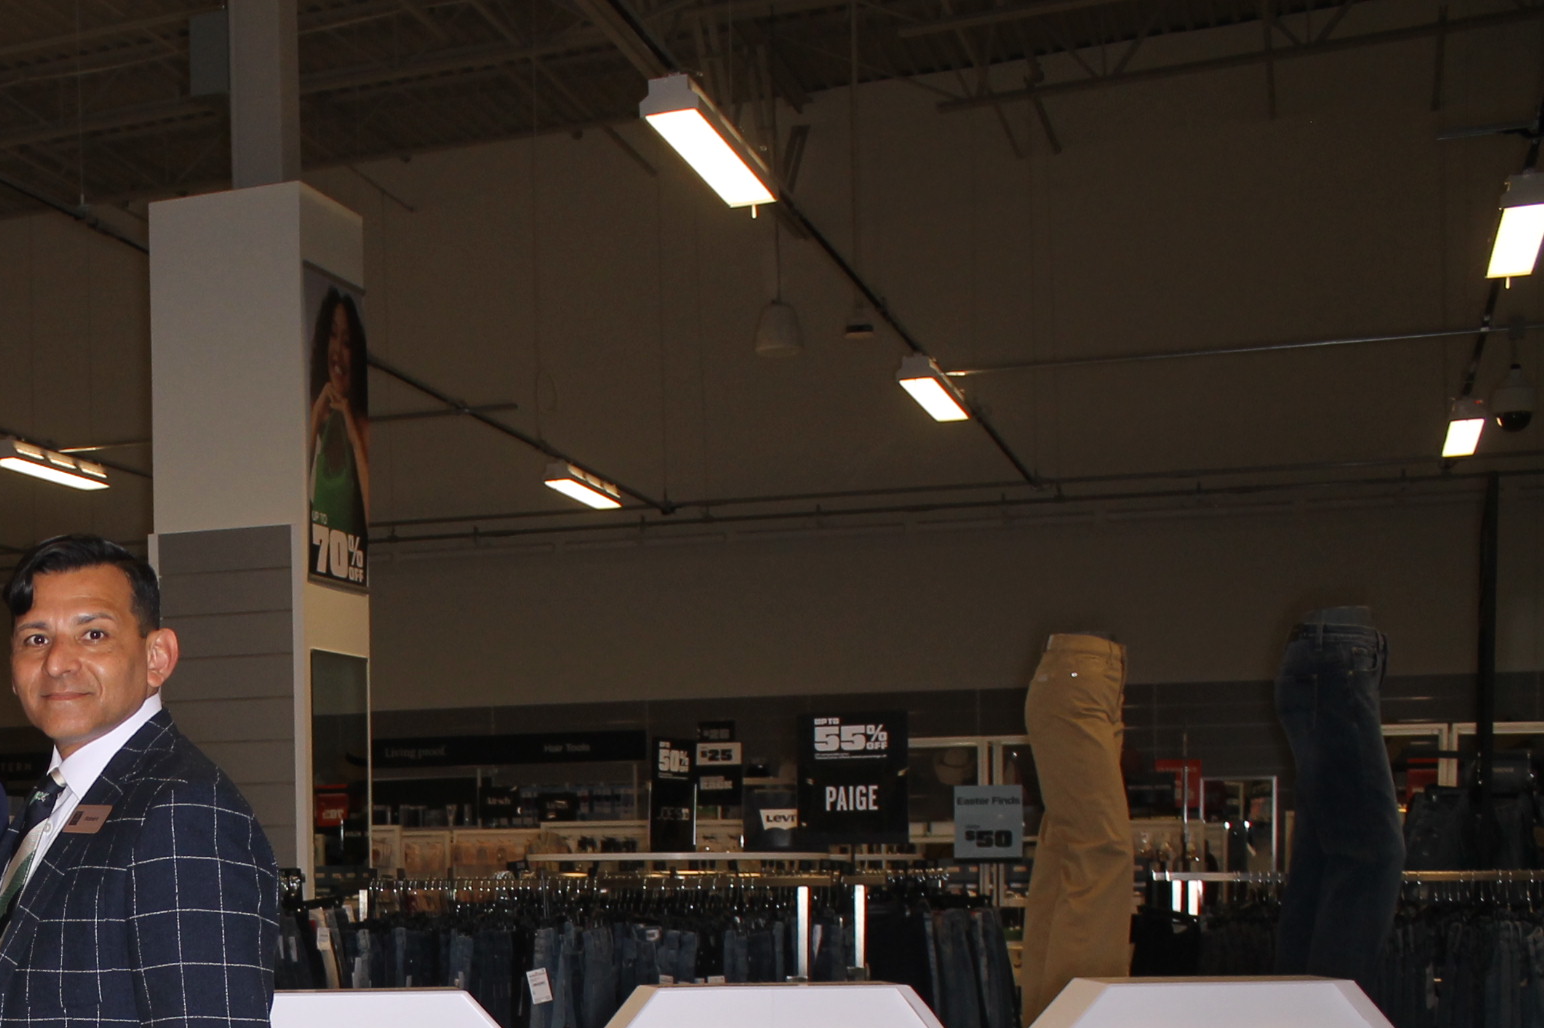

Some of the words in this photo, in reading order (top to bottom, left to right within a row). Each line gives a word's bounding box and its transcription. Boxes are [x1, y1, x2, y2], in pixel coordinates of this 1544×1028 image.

[312, 523, 364, 578] 70%
[348, 566, 364, 583] OFF
[814, 724, 888, 752] 55%
[866, 741, 888, 750] OFF
[701, 749, 732, 761] $25
[824, 785, 879, 812] PAIGE
[957, 797, 989, 805] Easter
[992, 796, 1020, 805] Finds
[965, 830, 1012, 848] $50
